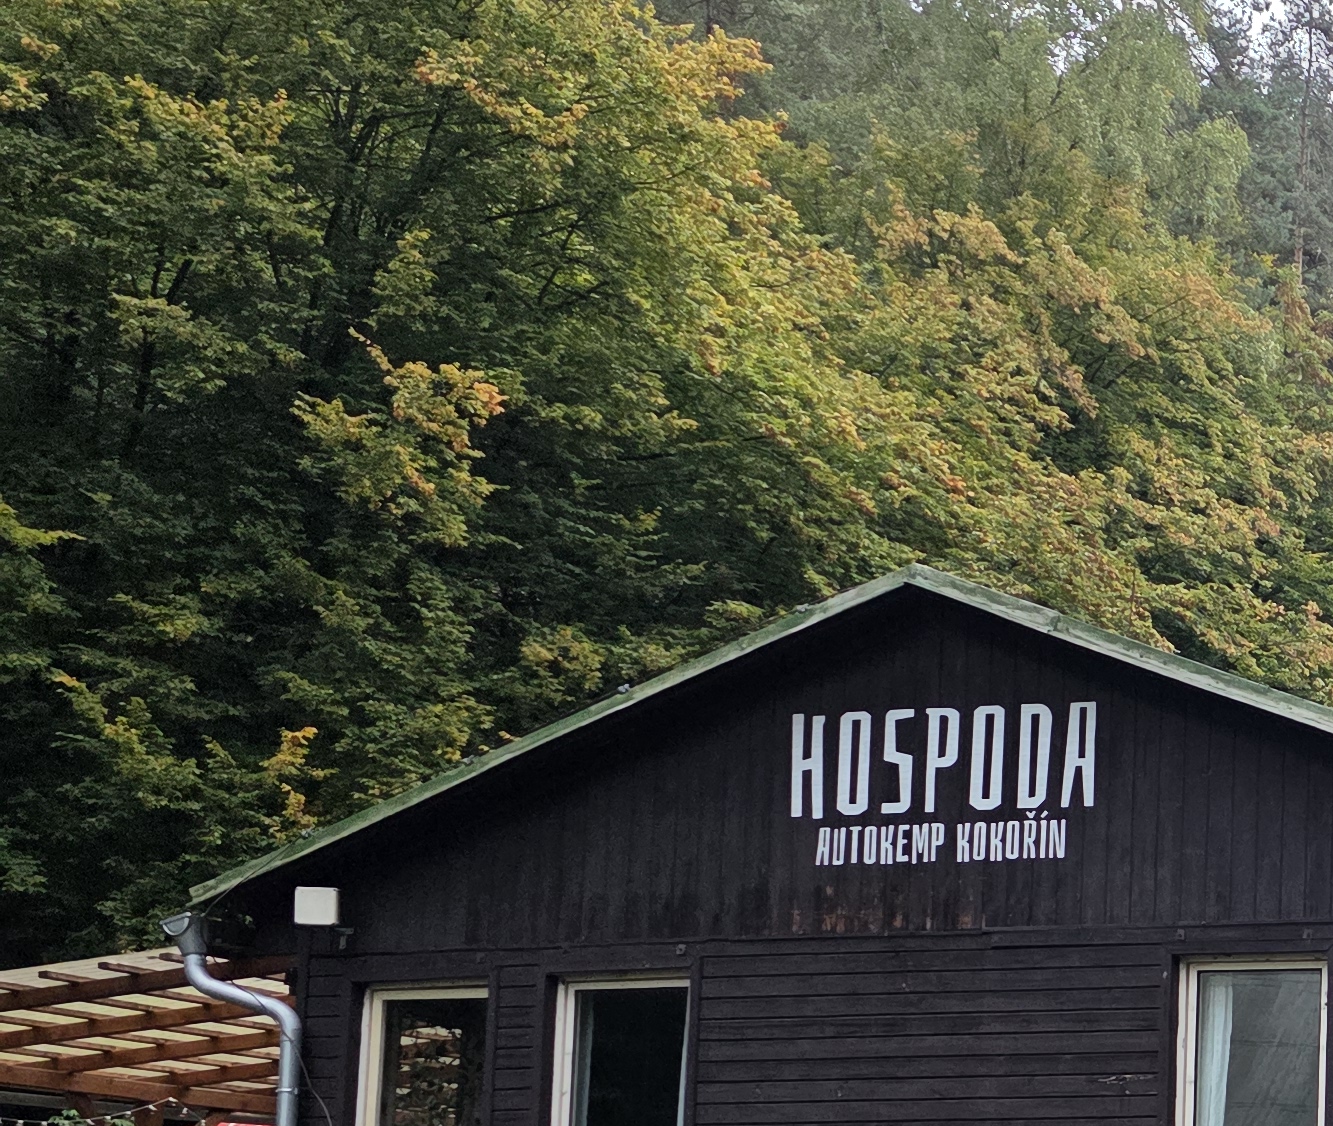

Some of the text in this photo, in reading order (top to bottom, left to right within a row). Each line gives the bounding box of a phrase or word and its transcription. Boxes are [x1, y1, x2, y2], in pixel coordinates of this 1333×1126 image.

[790, 701, 1097, 819] HOSPODA
[815, 810, 1066, 866] AUTOKEMP KOKOŘÍN
